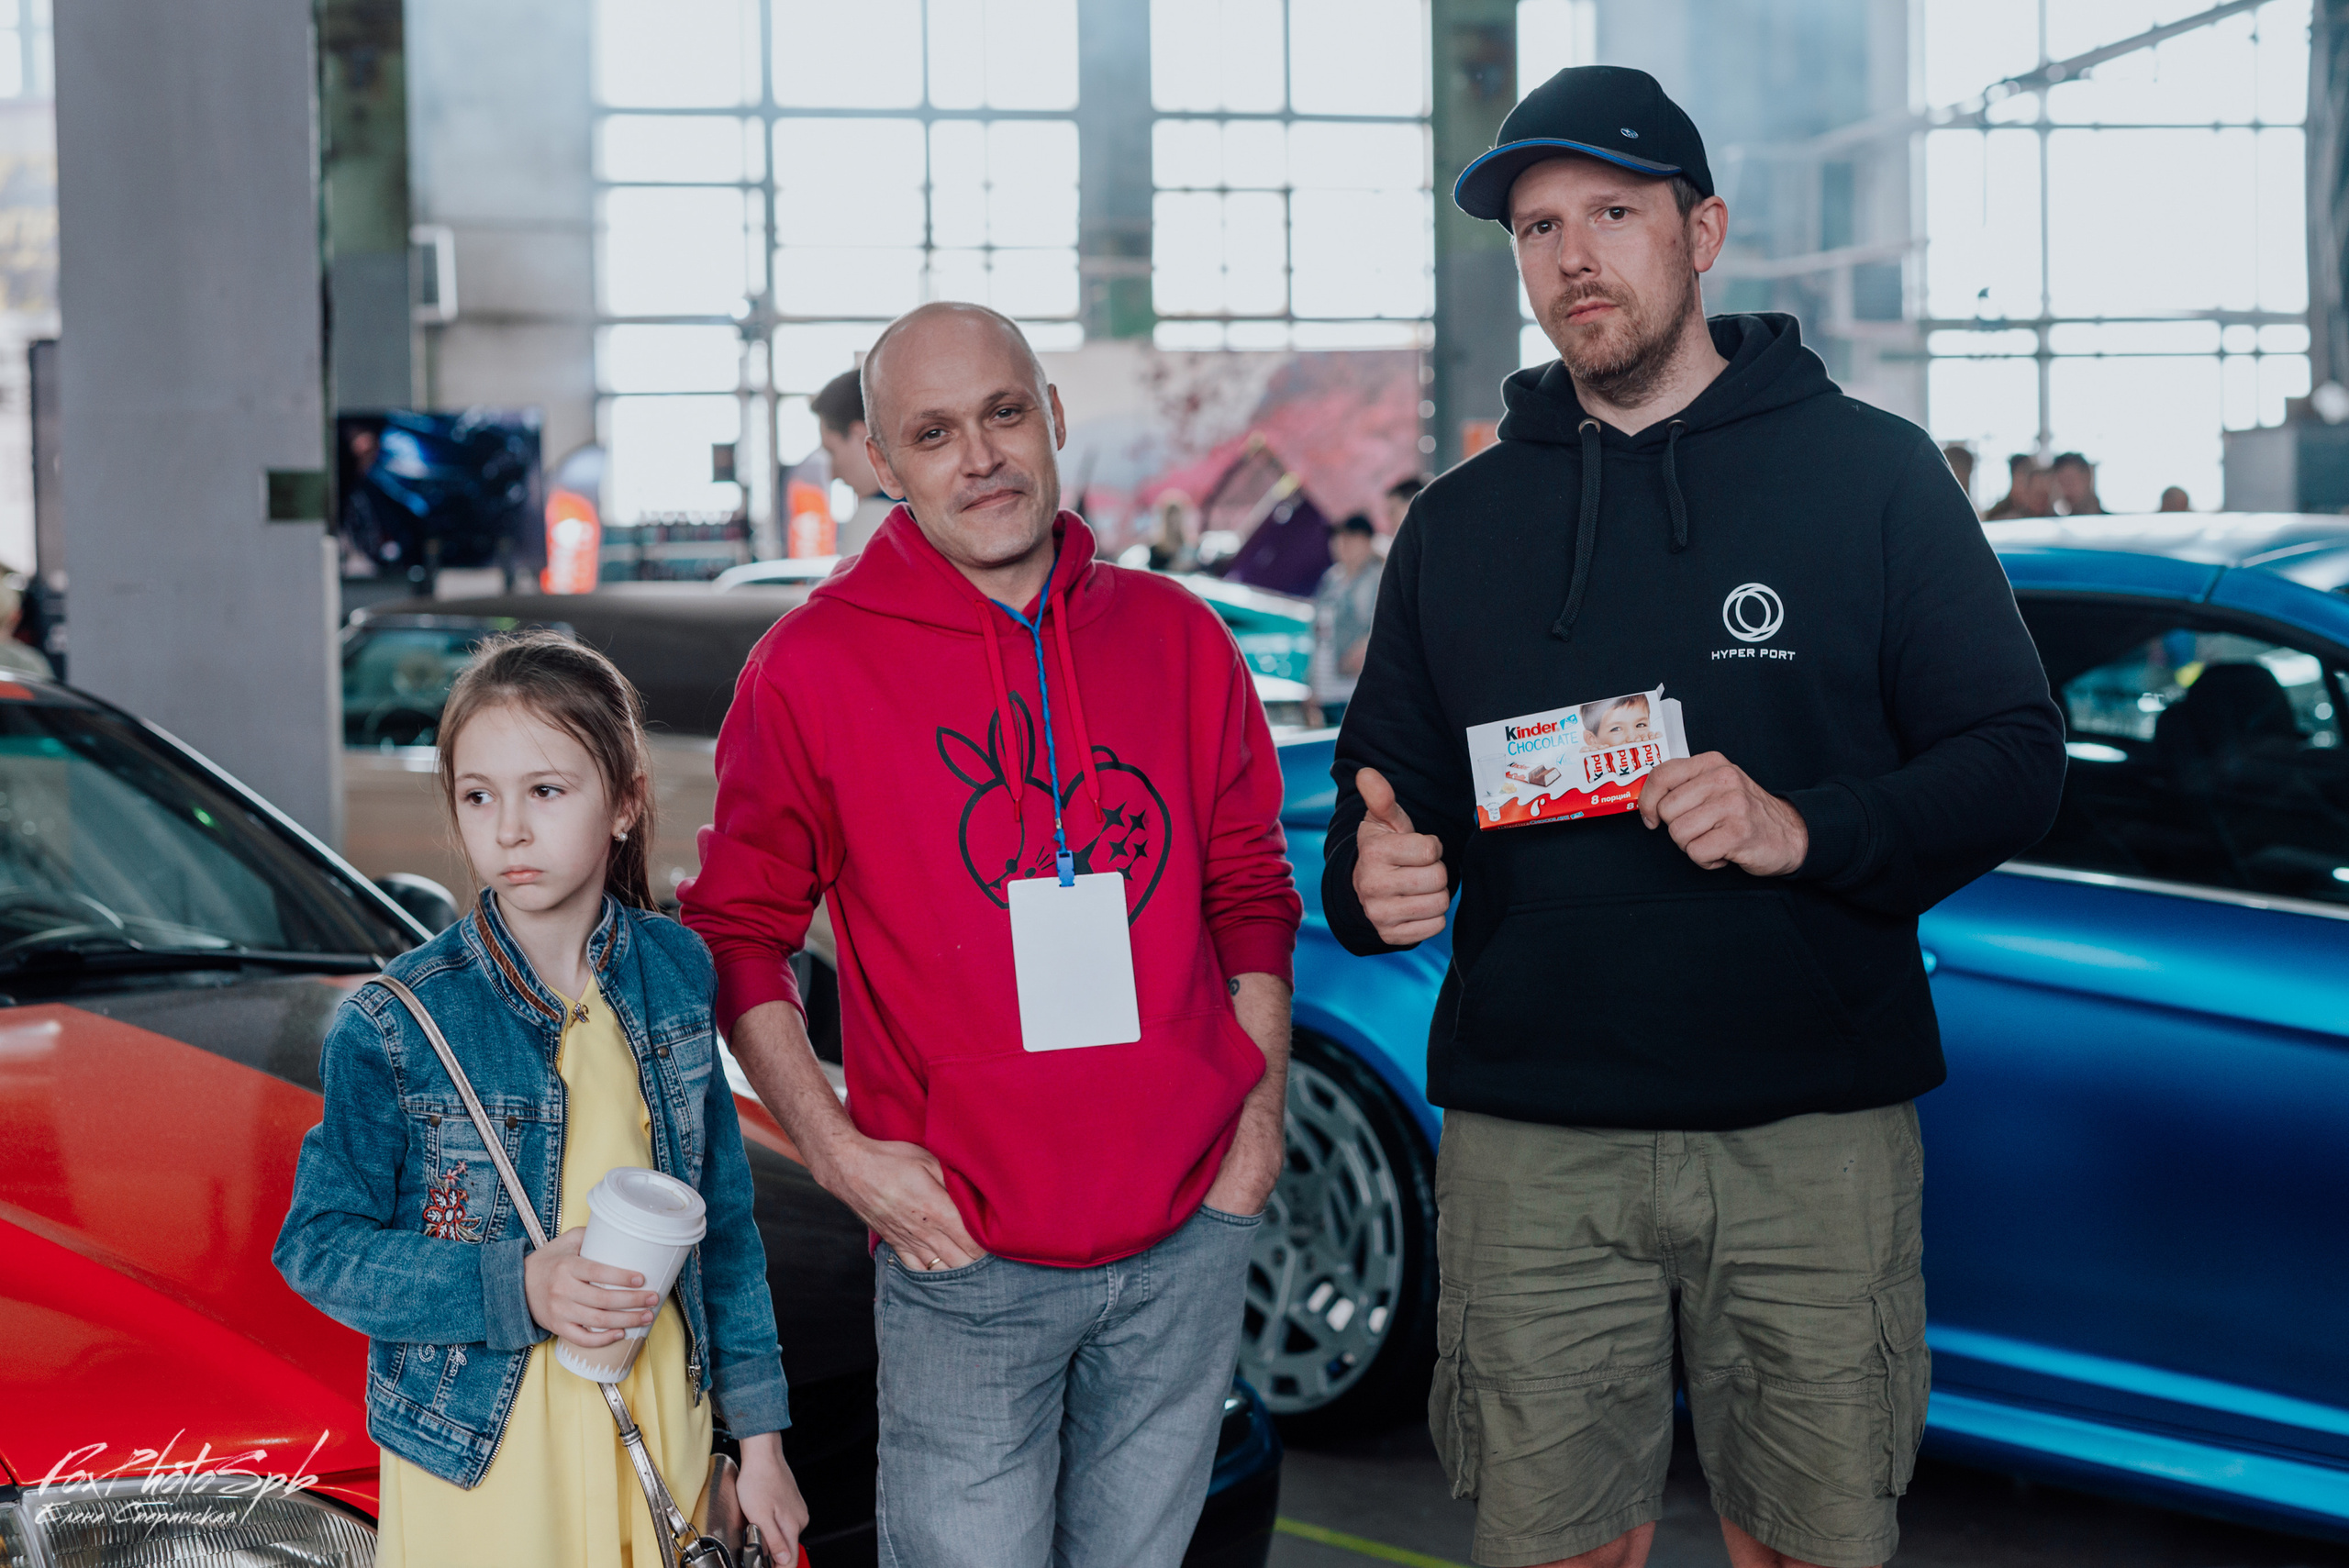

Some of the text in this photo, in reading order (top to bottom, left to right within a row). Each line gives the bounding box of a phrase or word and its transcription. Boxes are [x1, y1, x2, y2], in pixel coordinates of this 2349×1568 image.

[1711, 648, 1796, 661] HYPER PORT
[1505, 721, 1558, 741] Kinder
[1508, 731, 1579, 756] CHOCOLATE
[1590, 791, 1631, 805] 8 порций
[1626, 802, 1635, 810] 8
